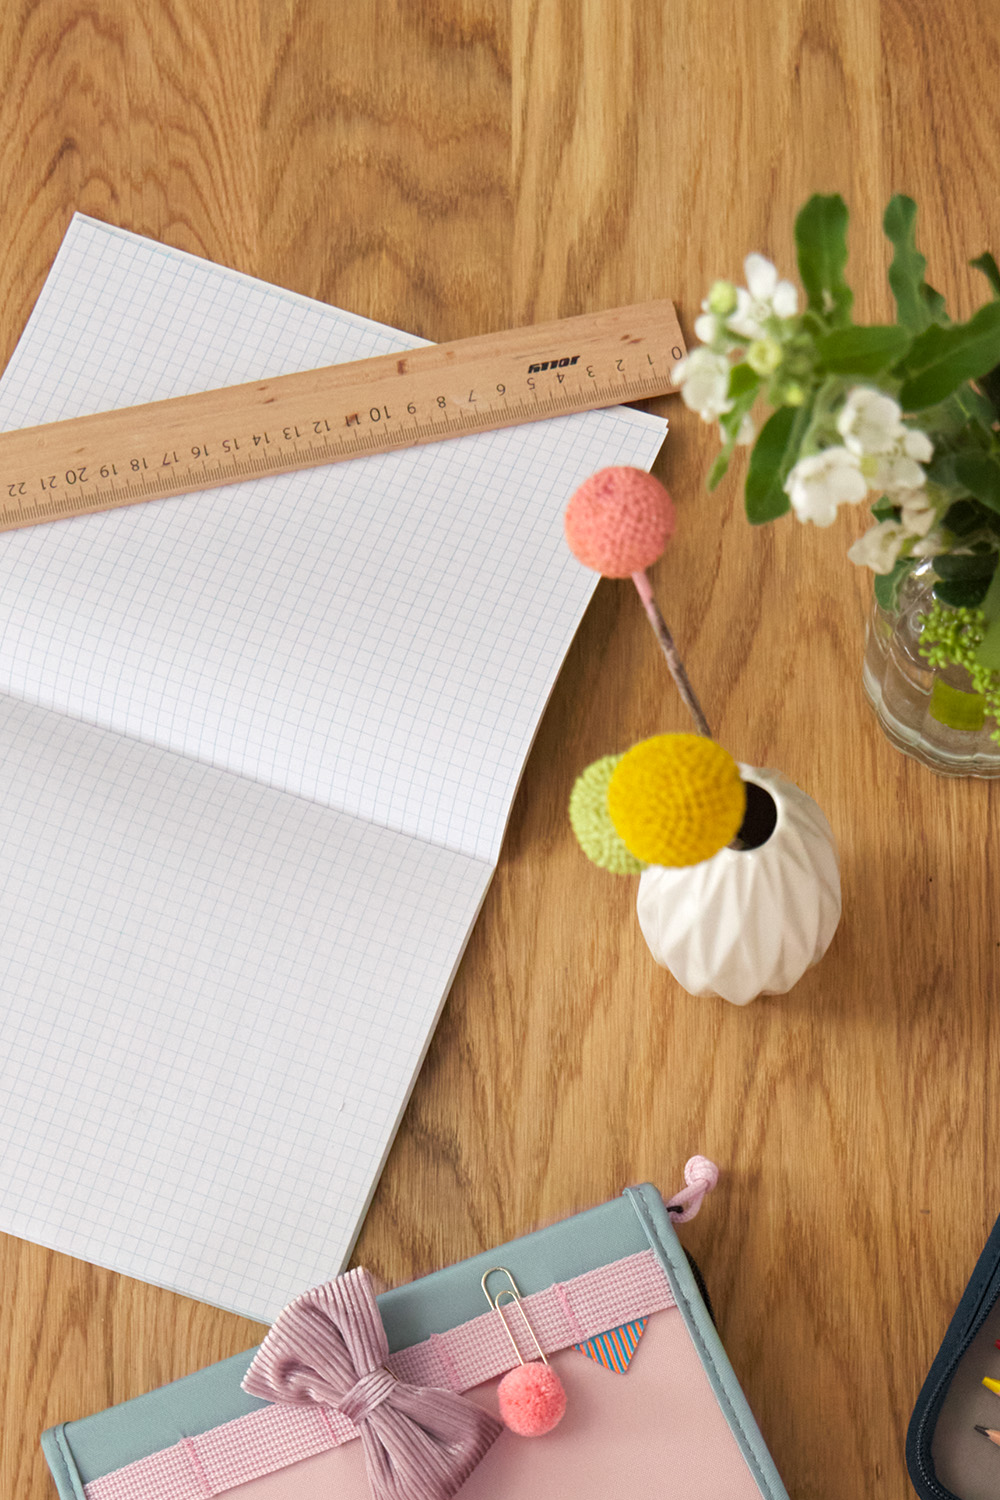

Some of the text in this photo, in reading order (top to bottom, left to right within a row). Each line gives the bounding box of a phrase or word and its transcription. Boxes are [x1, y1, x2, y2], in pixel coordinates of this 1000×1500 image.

[7, 346, 683, 497] 0 1 2 3 4 5 6 7 8 9 10 11 12 13 14 15 16 17 18 19 20 21 22
